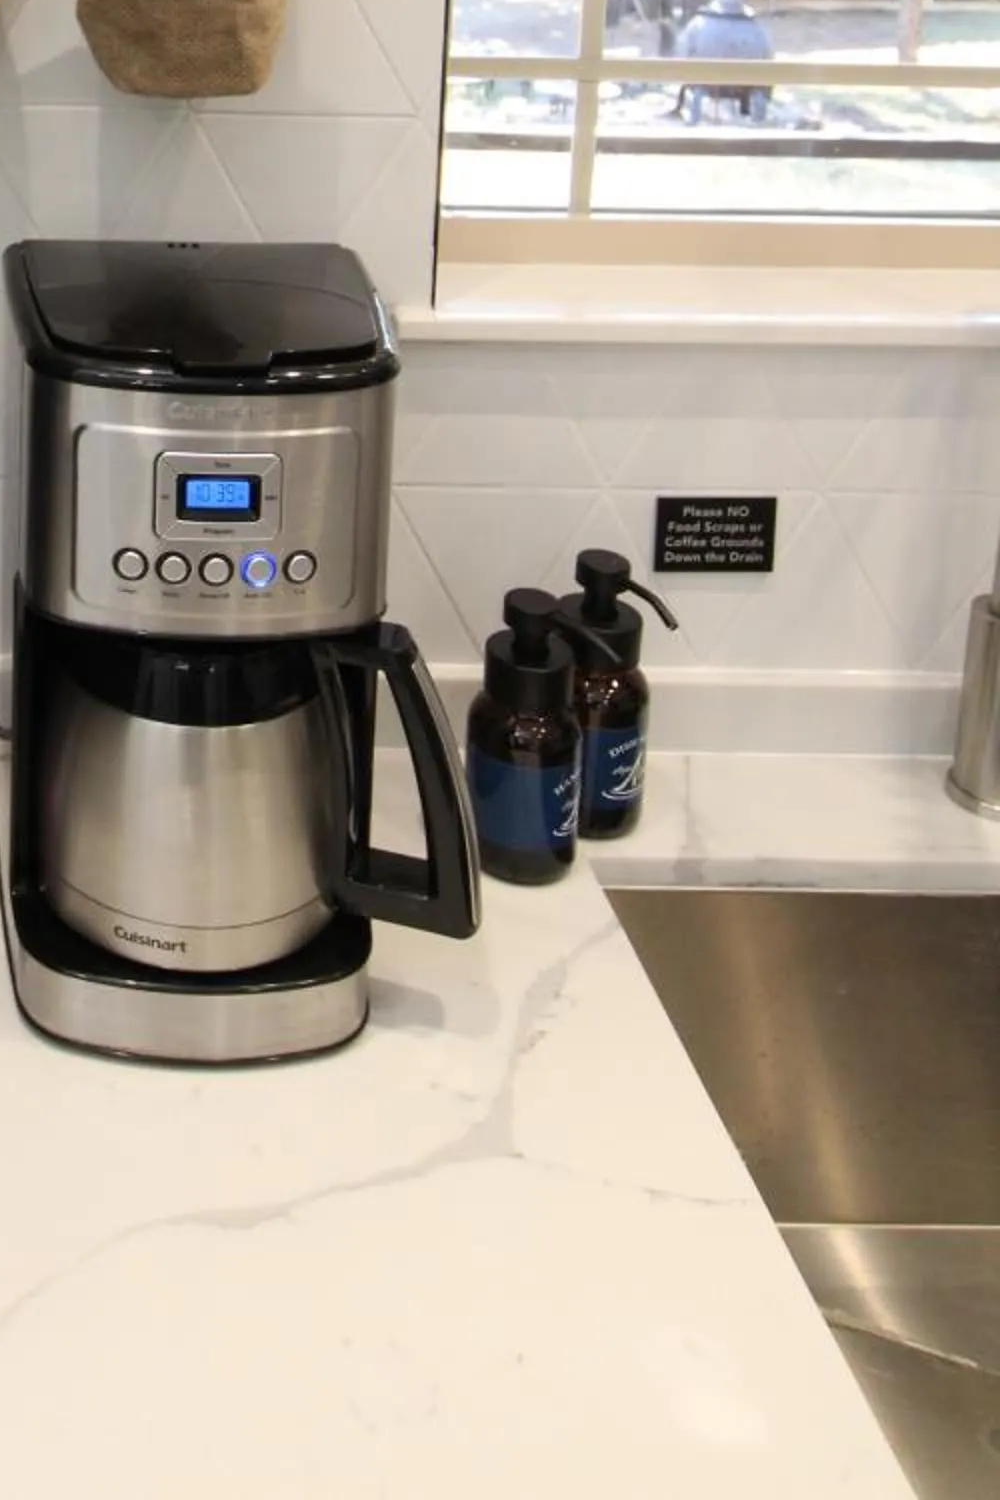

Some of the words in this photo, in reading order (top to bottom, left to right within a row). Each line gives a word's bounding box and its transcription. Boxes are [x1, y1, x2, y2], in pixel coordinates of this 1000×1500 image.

[682, 504, 723, 517] Please
[727, 505, 750, 517] NO
[667, 520, 701, 533] Food
[703, 521, 745, 536] Scraps
[749, 523, 763, 533] or
[664, 535, 707, 548] Coffee
[709, 535, 764, 548] Grounds
[663, 551, 701, 563] Down
[704, 551, 725, 563] the
[728, 551, 764, 563] Drain
[112, 924, 188, 955] Cuisinart
